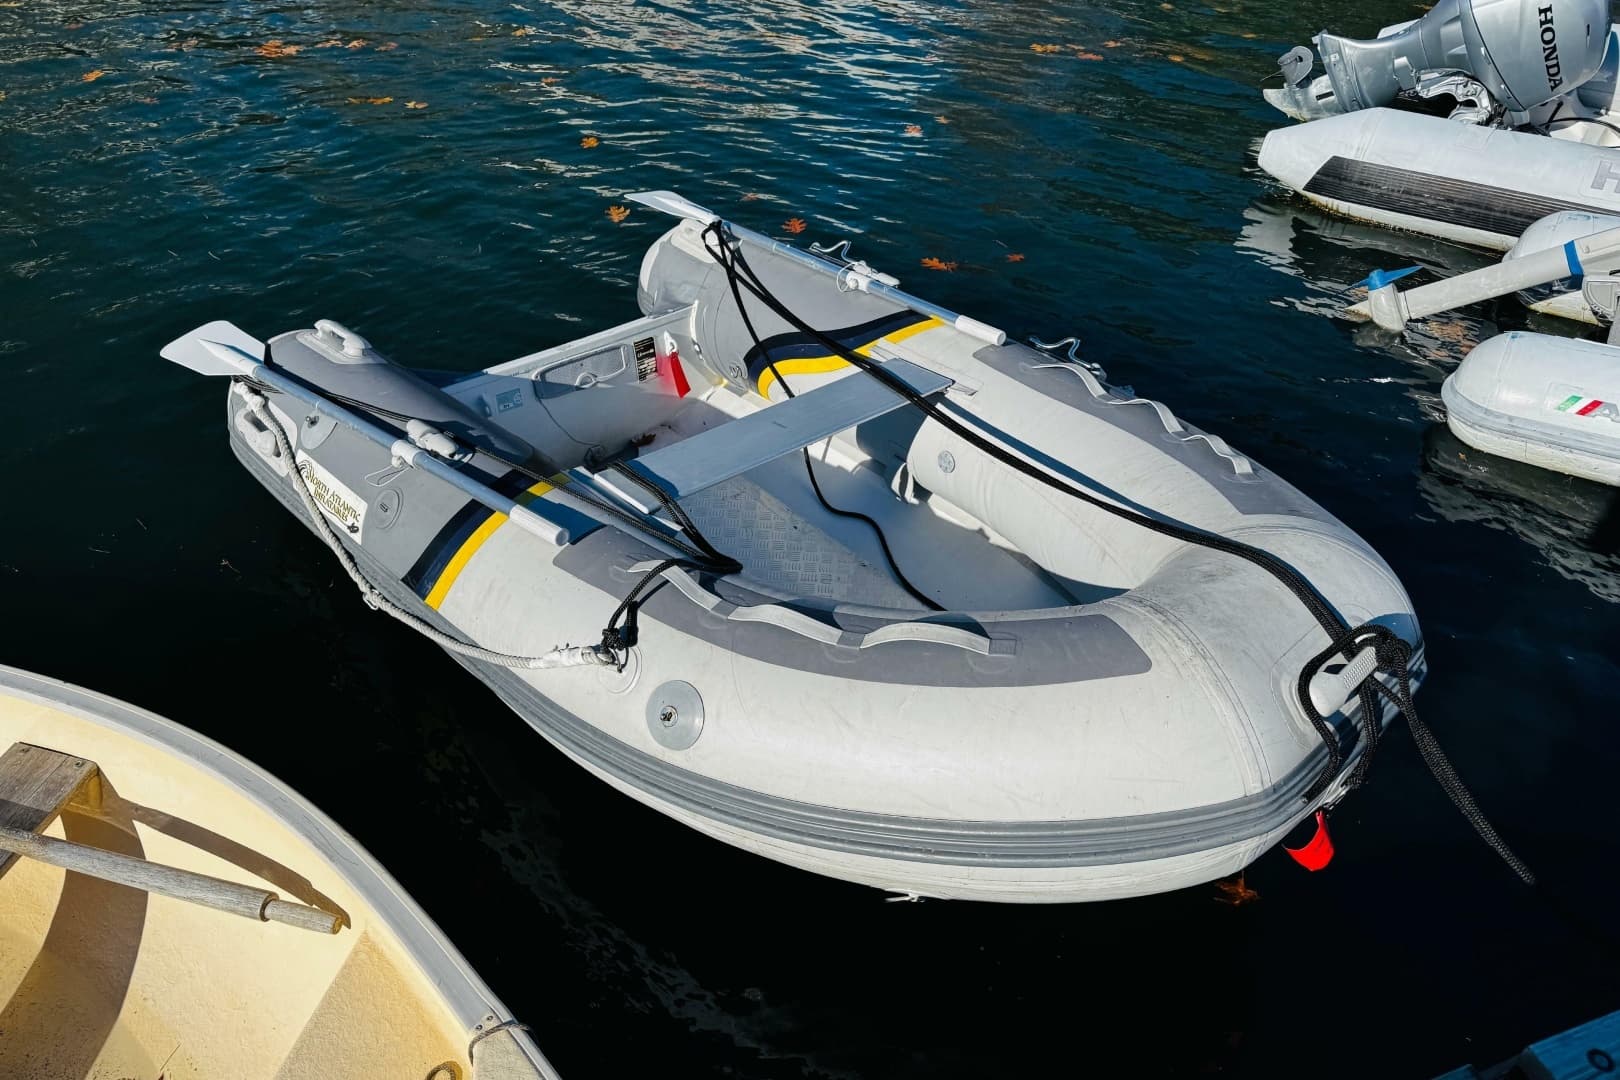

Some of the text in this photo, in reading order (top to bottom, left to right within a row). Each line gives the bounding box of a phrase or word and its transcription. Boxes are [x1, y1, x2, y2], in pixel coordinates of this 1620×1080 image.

[1538, 4, 1563, 92] HONDA
[305, 465, 361, 522] NORTH ATLANTIC
[313, 487, 348, 522] INFLATABLES
